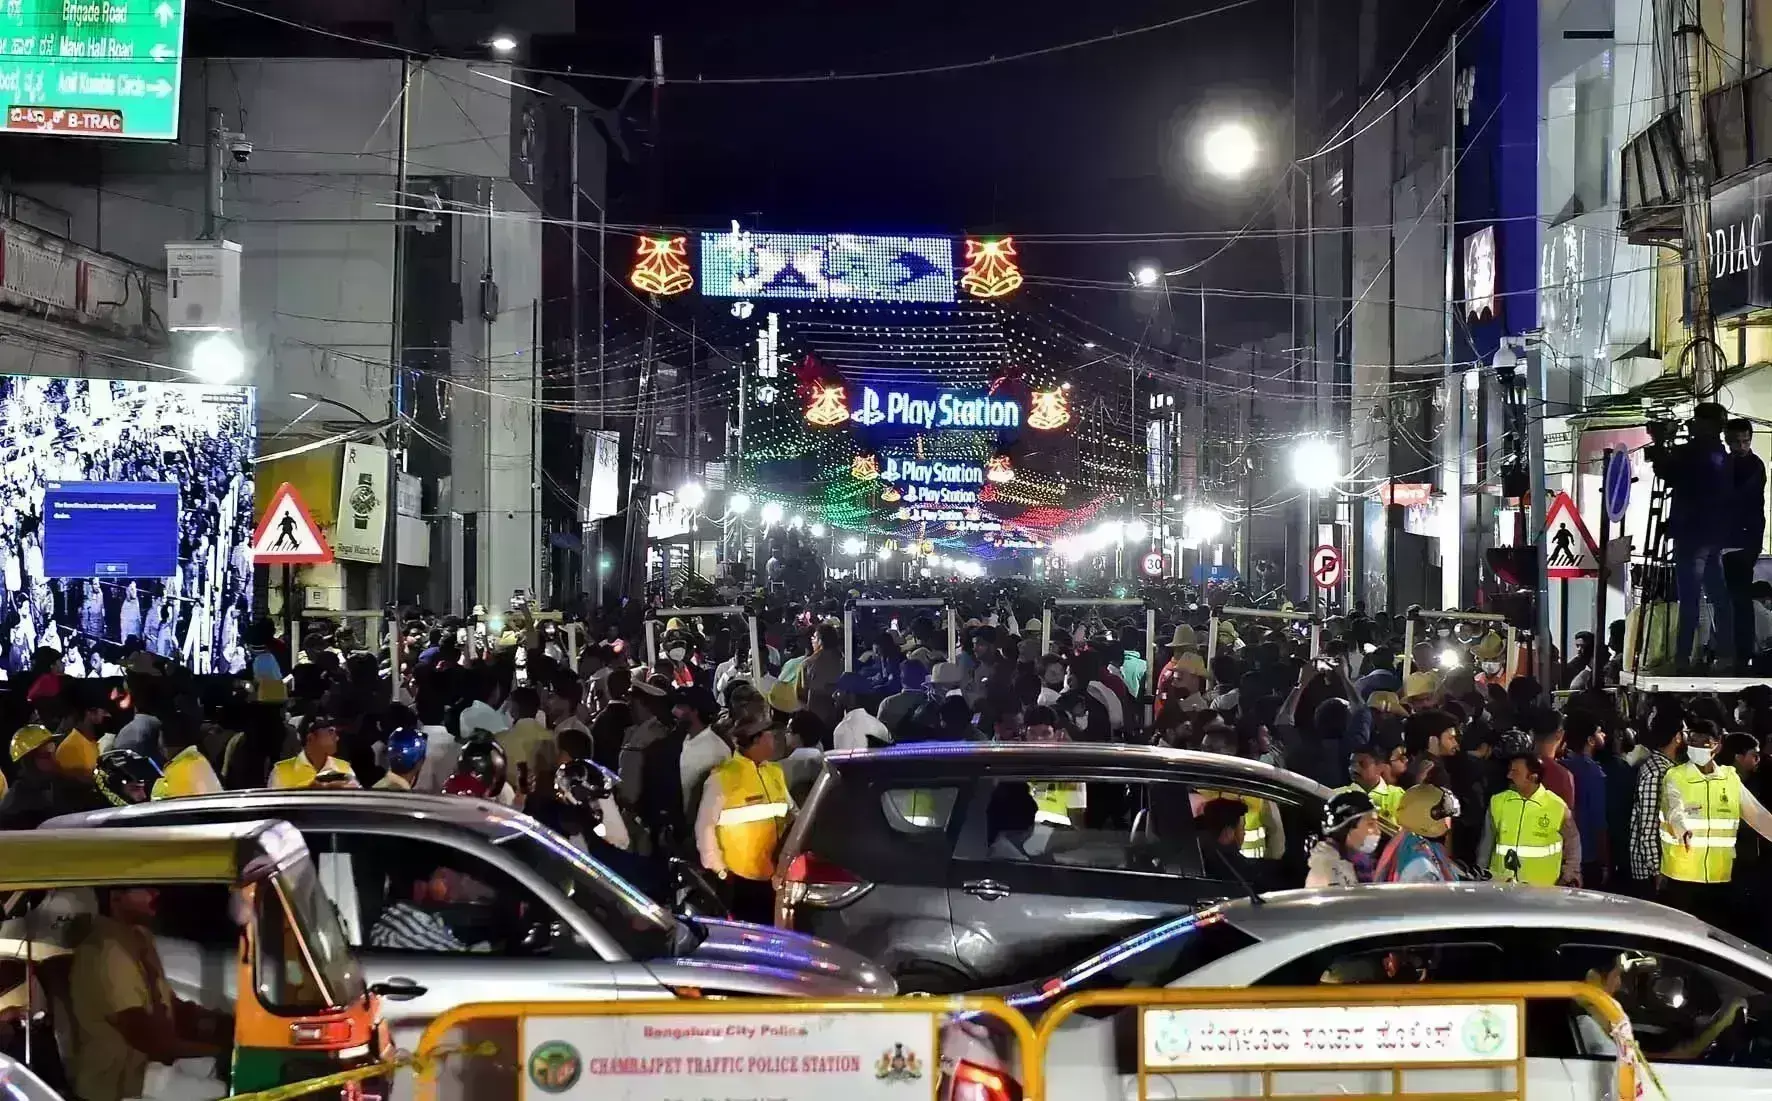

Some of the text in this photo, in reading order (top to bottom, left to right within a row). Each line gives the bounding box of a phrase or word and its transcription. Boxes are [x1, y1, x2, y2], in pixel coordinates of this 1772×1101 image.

[62, 0, 128, 26] Brigade Road
[60, 35, 134, 61] Mayo Hall Road
[68, 113, 121, 130] B-TRAC
[1147, 558, 1162, 570] 30
[1322, 555, 1336, 582] P
[643, 1026, 721, 1039] Bengaluru
[725, 1025, 756, 1039] City
[686, 1056, 744, 1073] TRAFFIC
[747, 1055, 798, 1073] POLICE
[801, 1055, 860, 1073] STATION
